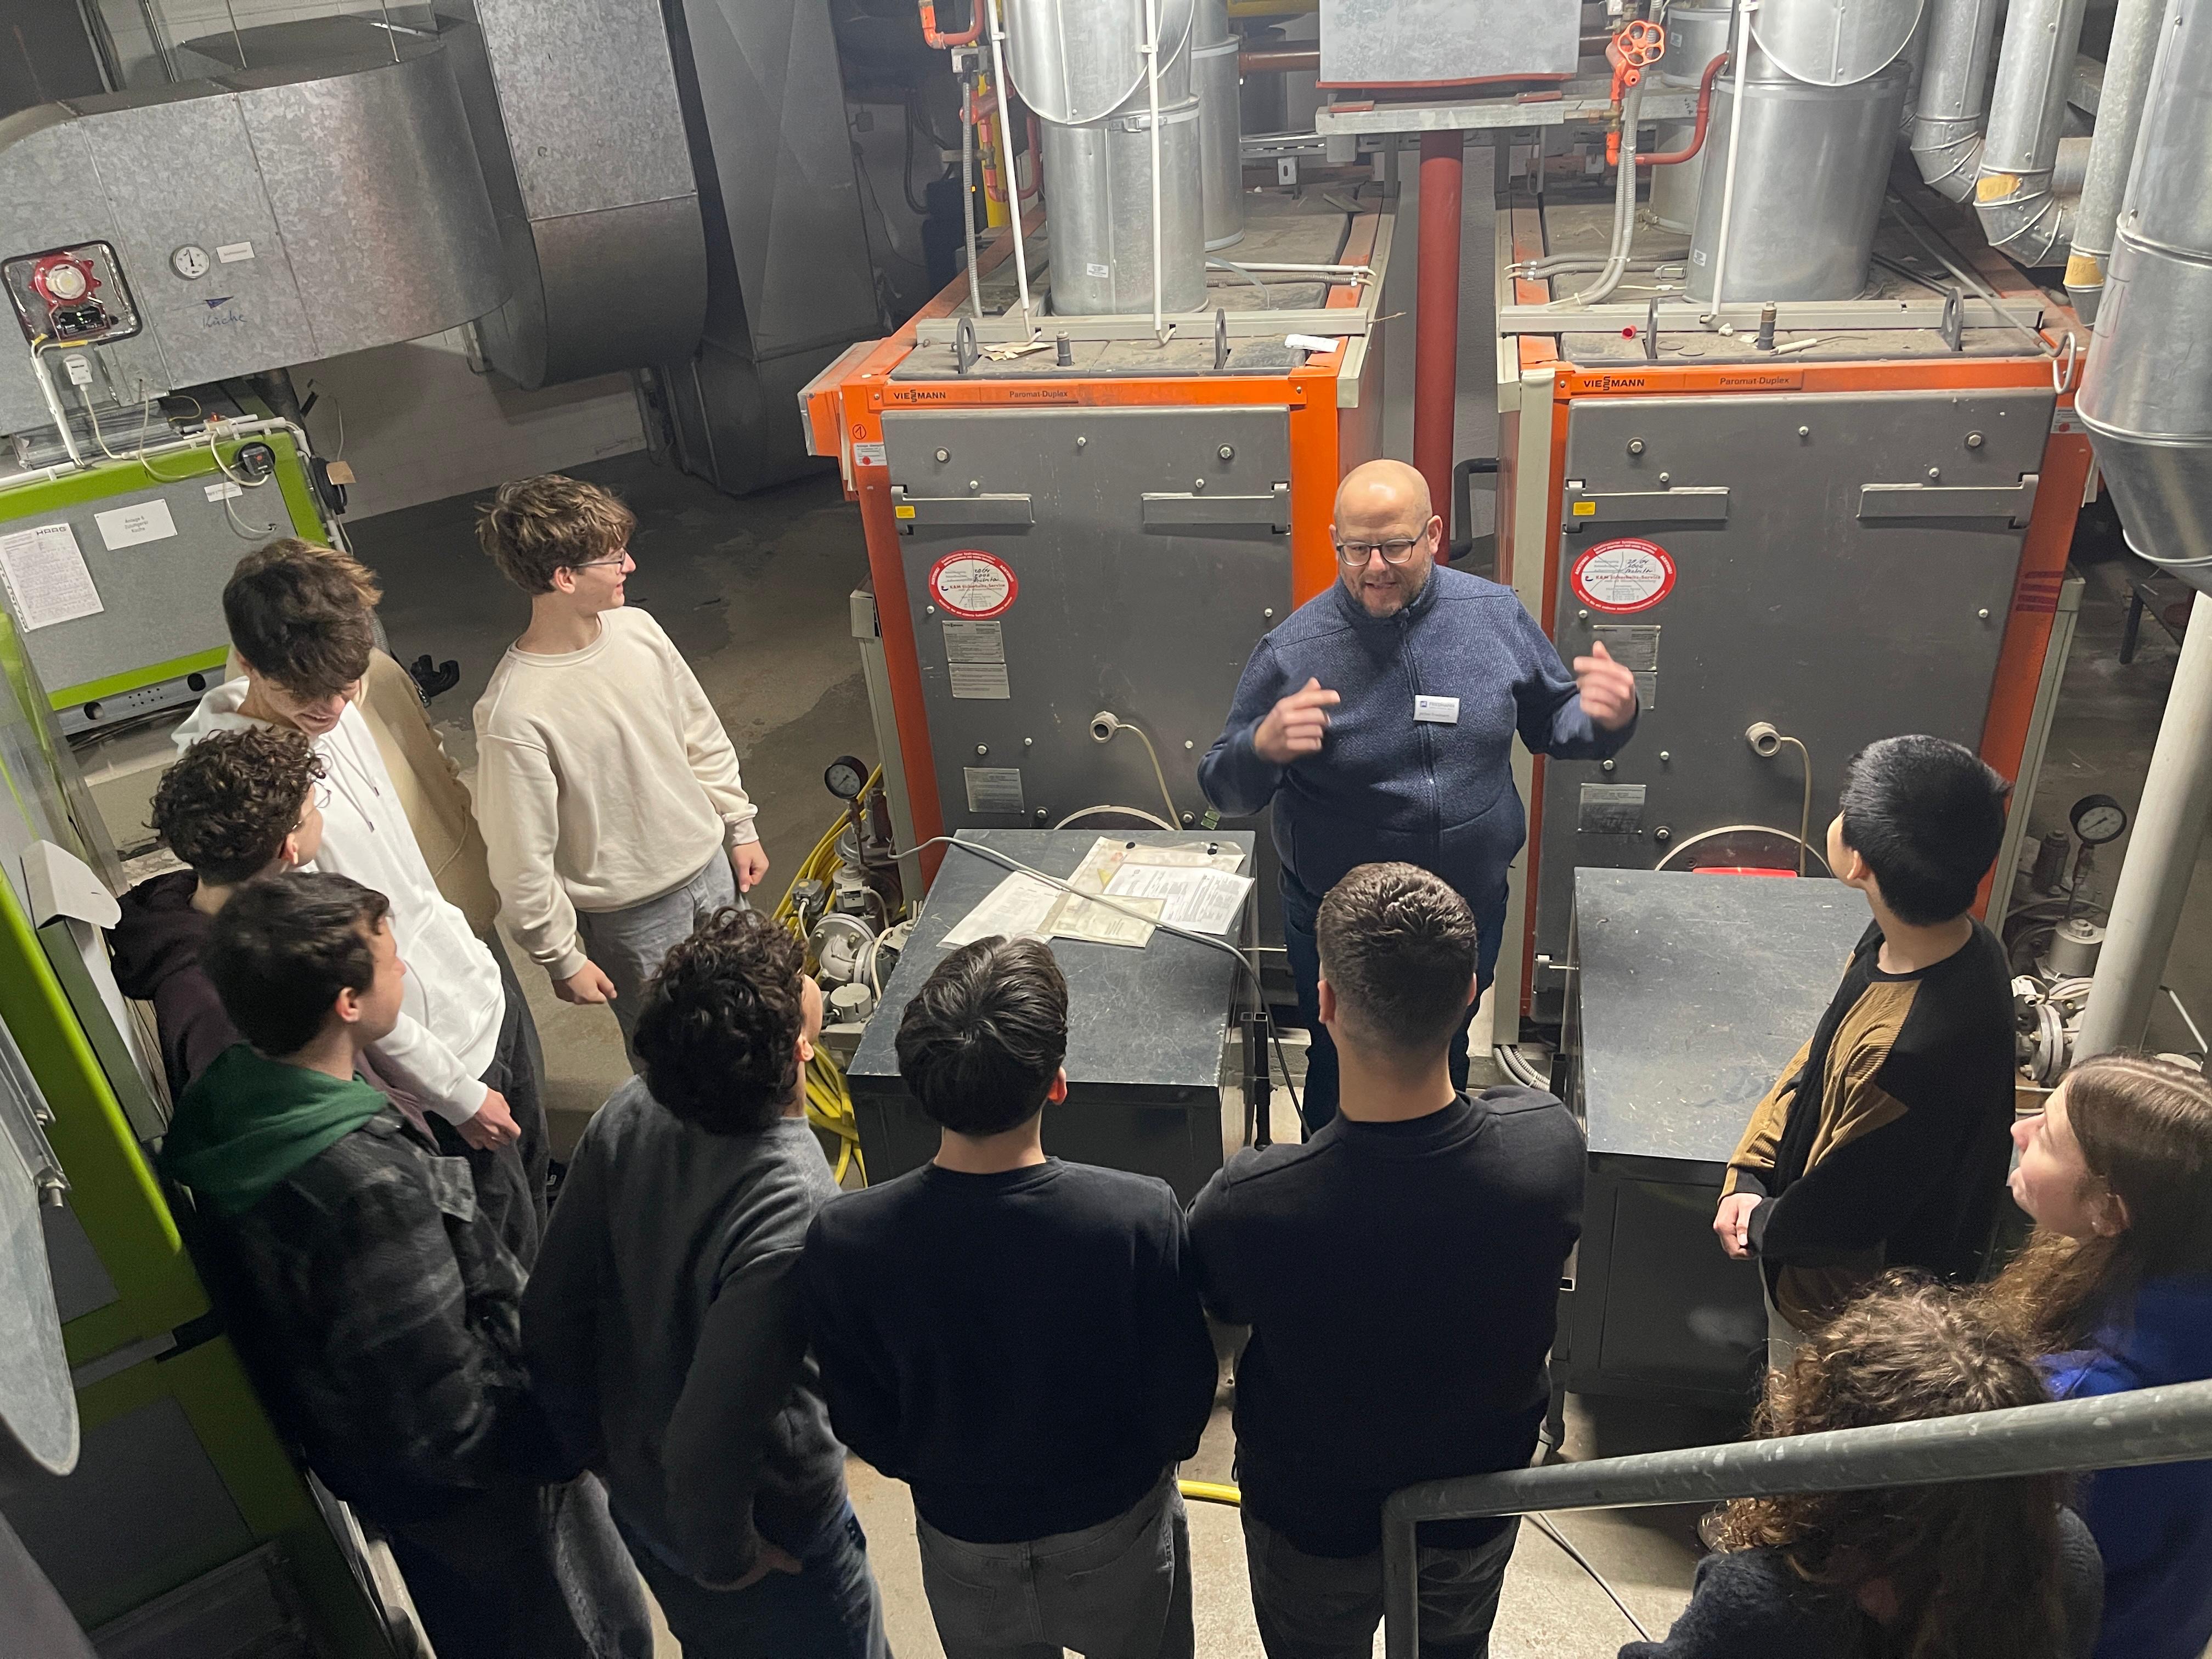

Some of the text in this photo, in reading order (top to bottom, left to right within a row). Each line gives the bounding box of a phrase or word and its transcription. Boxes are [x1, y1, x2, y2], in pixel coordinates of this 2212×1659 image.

[203, 311, 247, 329] Küche
[1584, 376, 1790, 391] VIESSMANN Paromat-Duplex
[894, 390, 1068, 403] VIESSMANN Paromat-Duplex
[36, 527, 66, 535] HAAG
